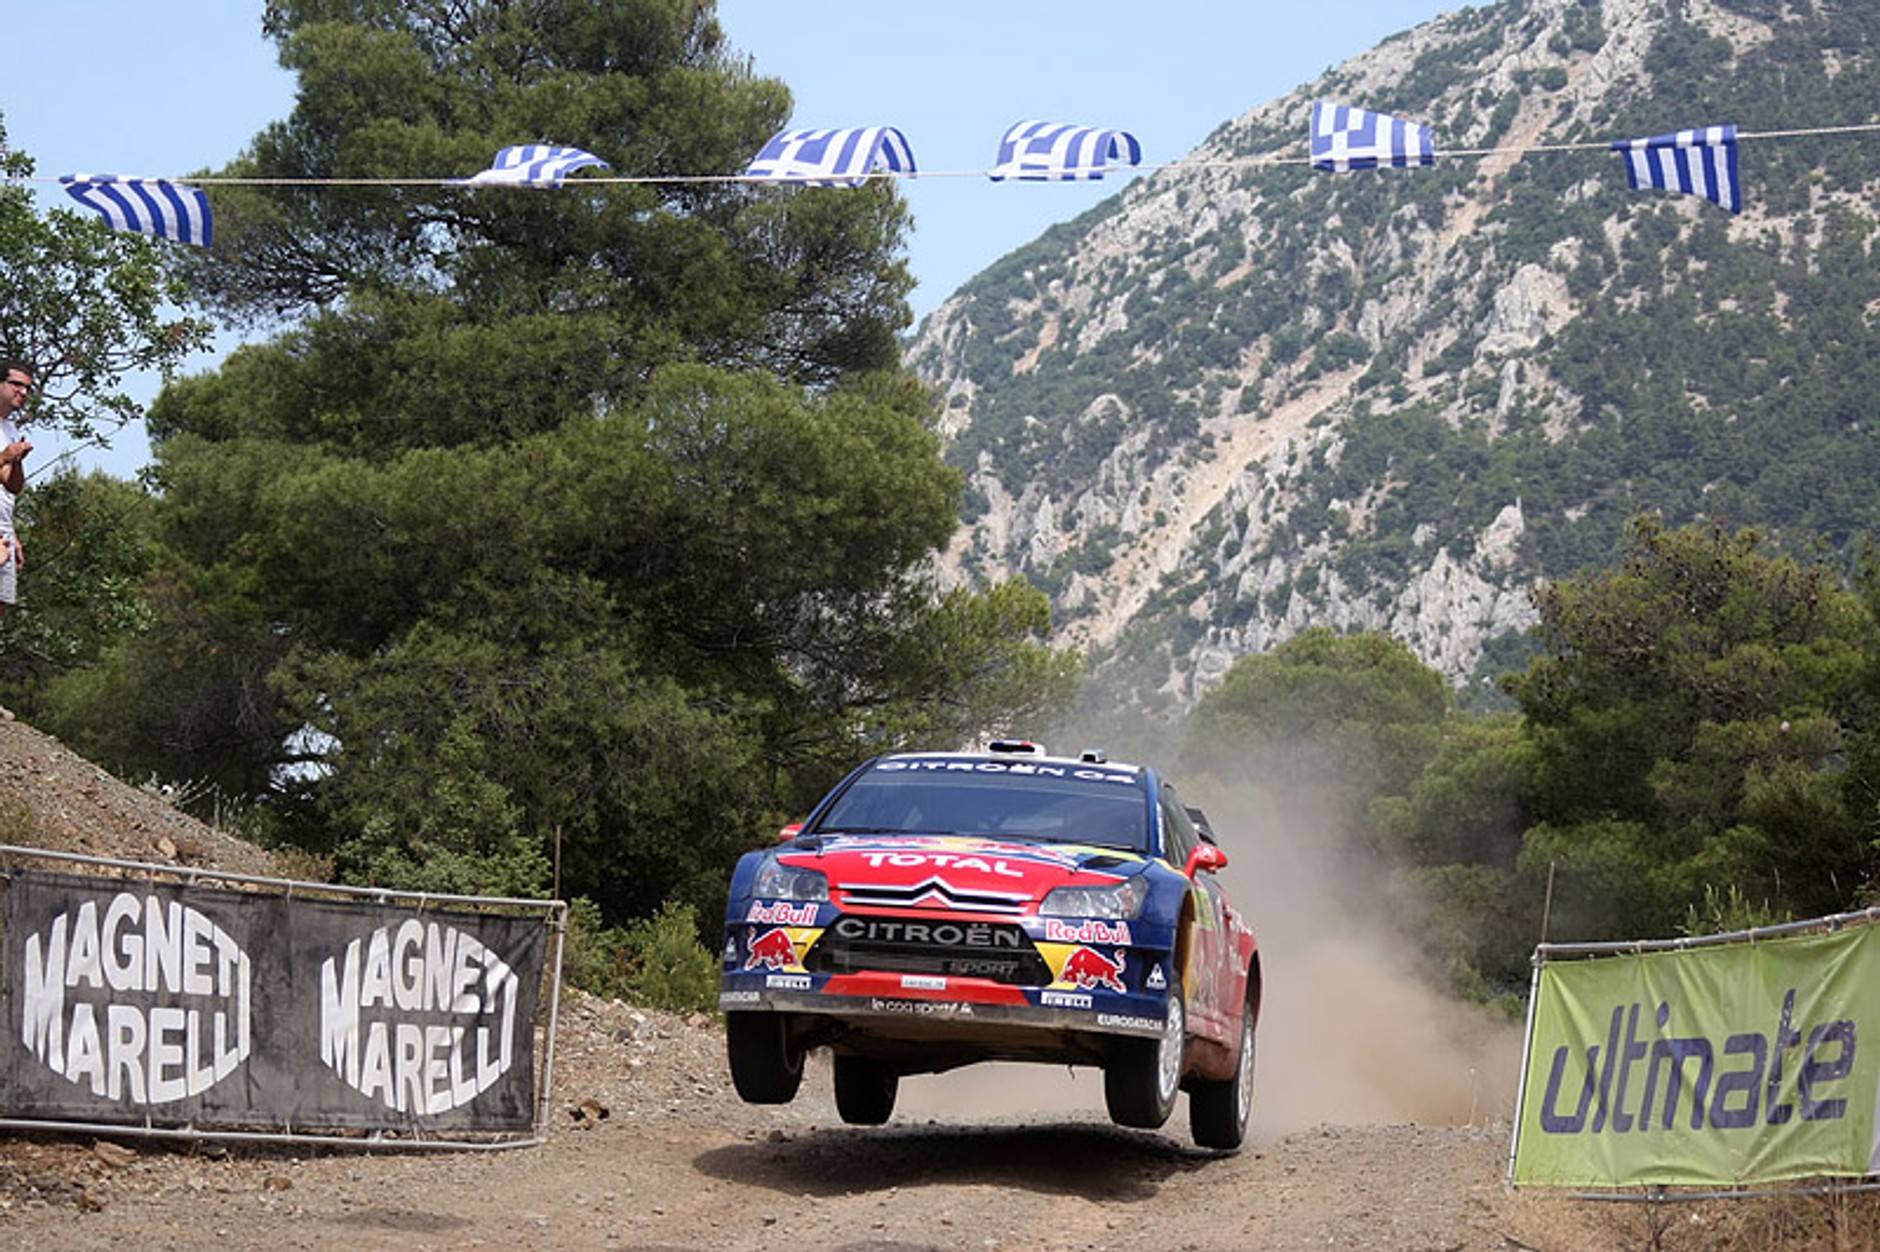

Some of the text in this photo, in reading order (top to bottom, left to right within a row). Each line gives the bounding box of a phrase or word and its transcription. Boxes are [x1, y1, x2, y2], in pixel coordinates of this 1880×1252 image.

[861, 852, 1023, 878] TOTAL
[775, 903, 819, 926] Bull
[836, 918, 1019, 948] CITROËN
[1046, 919, 1132, 945] Red Bull
[1540, 988, 1856, 1134] ultimate
